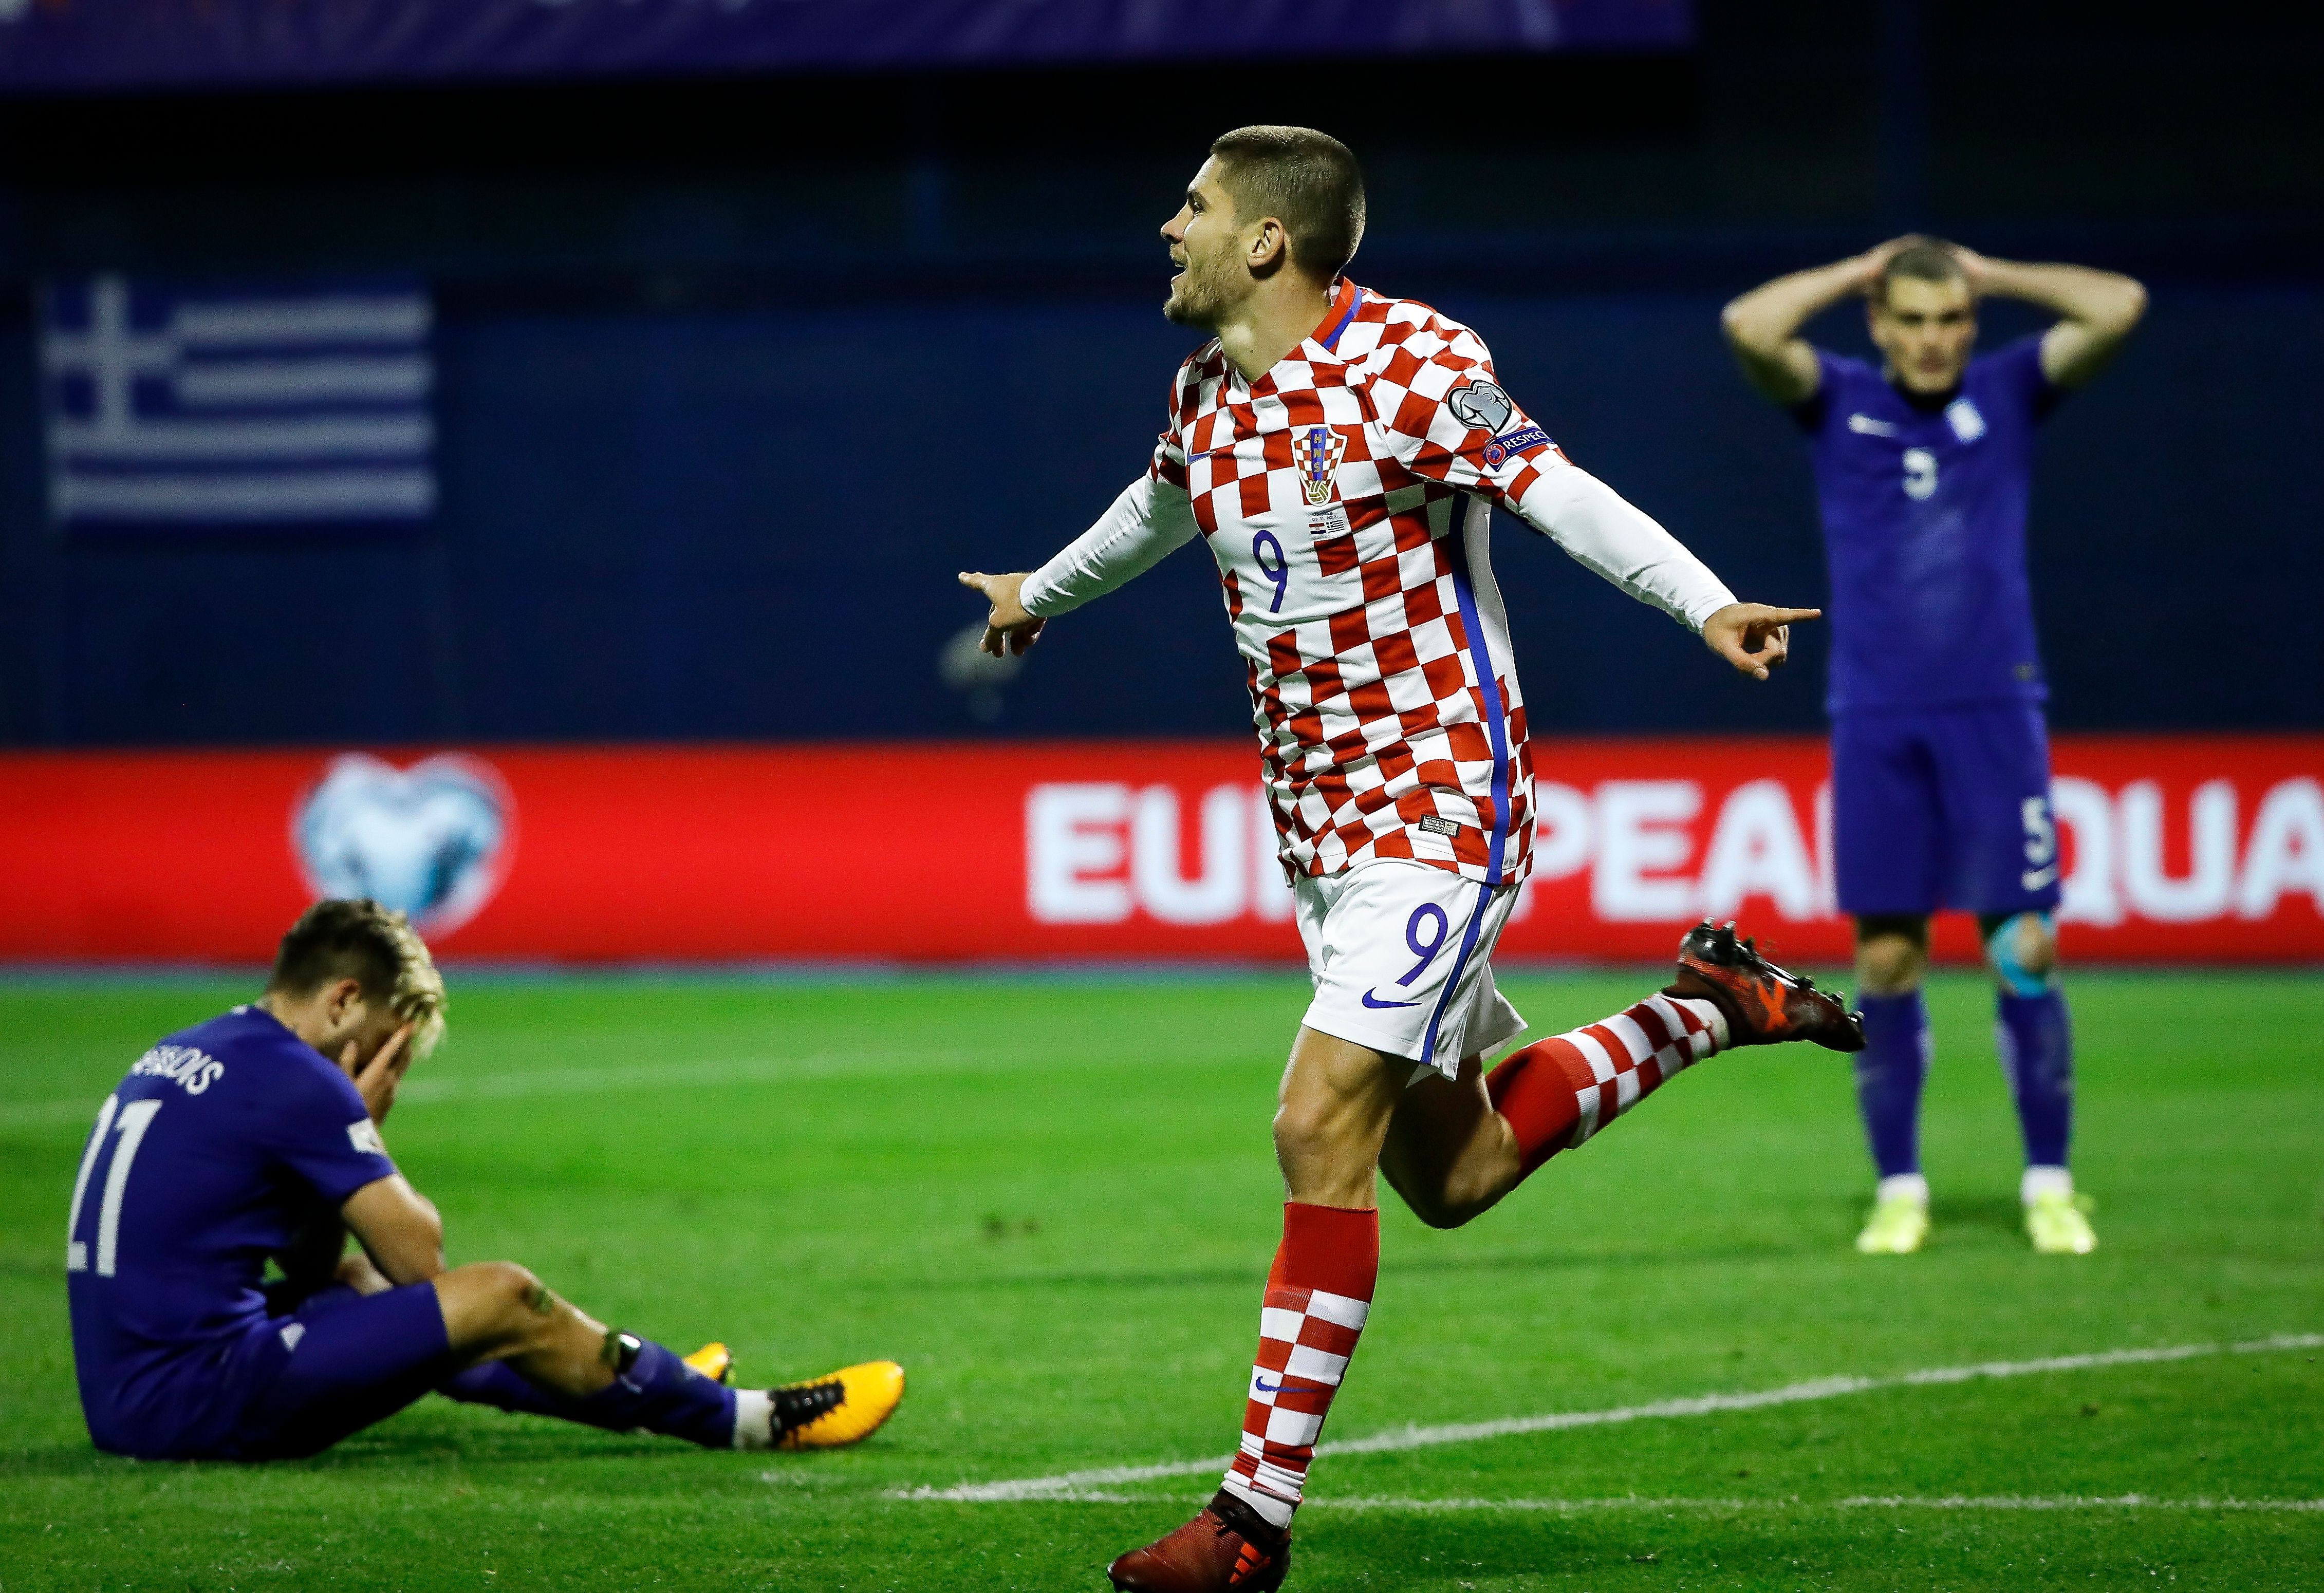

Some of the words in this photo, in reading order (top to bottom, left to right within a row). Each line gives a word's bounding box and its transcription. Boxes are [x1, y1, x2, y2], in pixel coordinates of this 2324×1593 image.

[1314, 433, 1323, 473] HNS
[1252, 530, 1288, 613] 9
[2021, 796, 2055, 865] 5
[1395, 902, 1448, 987] 9
